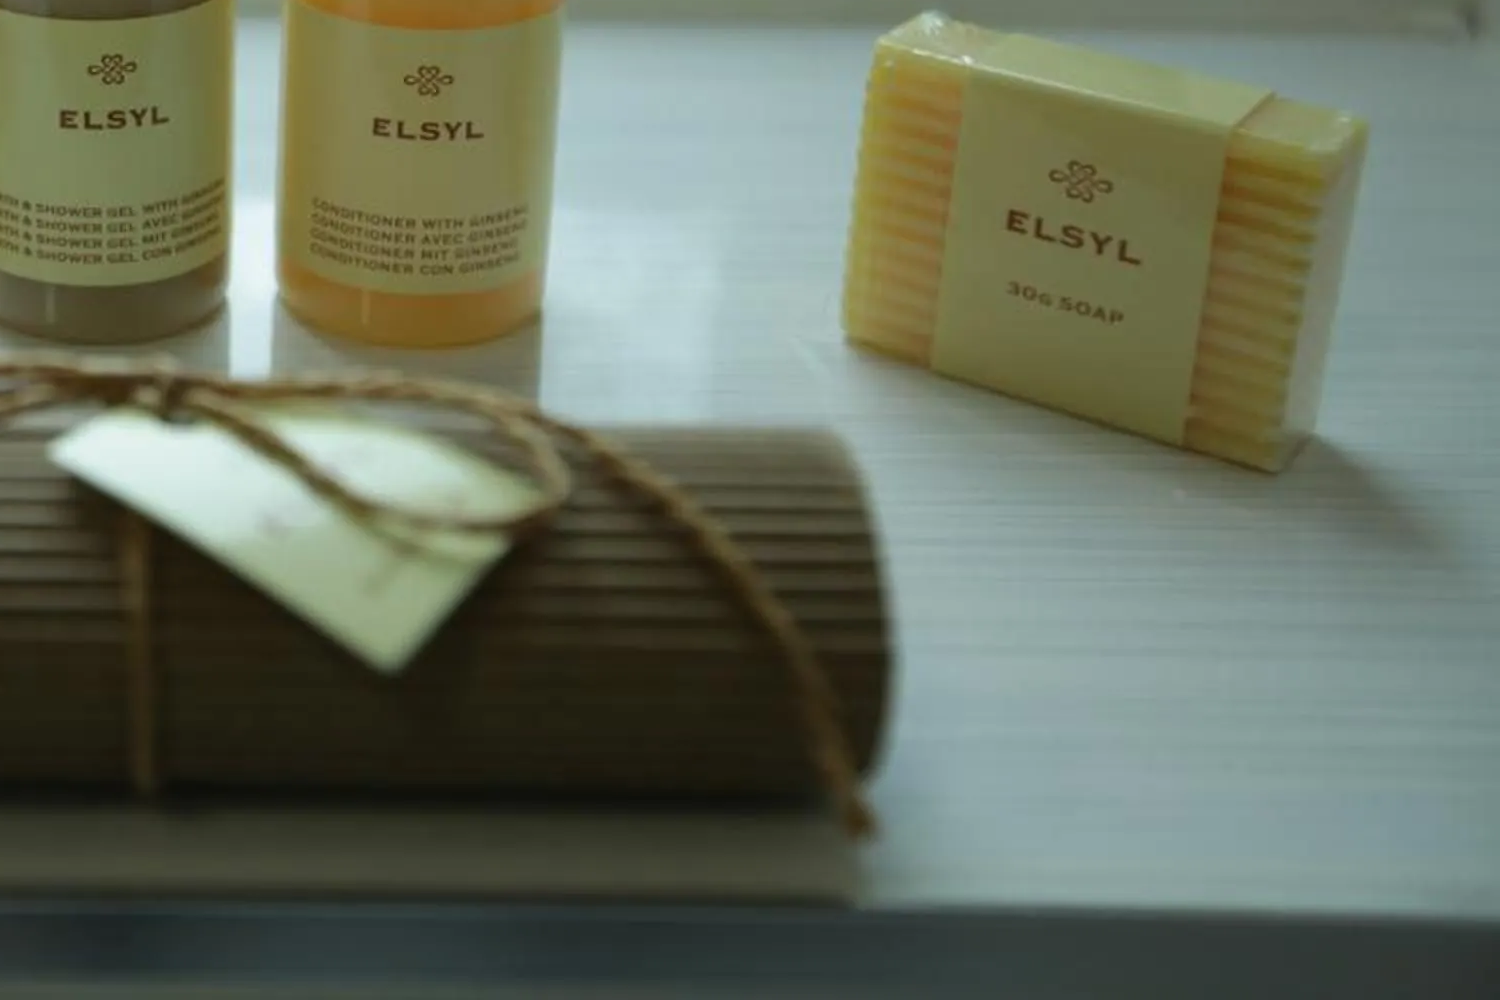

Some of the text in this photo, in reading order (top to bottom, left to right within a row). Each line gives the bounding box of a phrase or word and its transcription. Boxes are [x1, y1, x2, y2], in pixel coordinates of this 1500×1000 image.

[59, 106, 169, 130] ELSYL
[372, 117, 484, 141] ELSYL
[36, 203, 102, 218] SHOWER
[106, 206, 137, 218] GEL
[142, 199, 178, 213] WITH
[311, 197, 416, 229] CONDITIONER
[422, 217, 464, 230] WITH
[36, 218, 102, 233] SHOWER
[106, 222, 137, 233] GEL
[142, 214, 177, 229] AVEC
[311, 212, 415, 243] CONDITIONER
[421, 232, 465, 245] AVEC
[36, 234, 102, 249] SHOWER
[106, 238, 137, 249] GEL
[142, 232, 166, 244] MIT
[310, 227, 414, 259] CONDITIONER
[421, 248, 447, 260] MIT
[1005, 209, 1142, 266] ELSYL
[36, 249, 102, 264] SHOWER
[106, 252, 137, 264] GEL
[142, 247, 173, 261] CON
[310, 242, 413, 274] CONDITIONER
[419, 264, 453, 275] CON
[1059, 296, 1125, 324] SOAP
